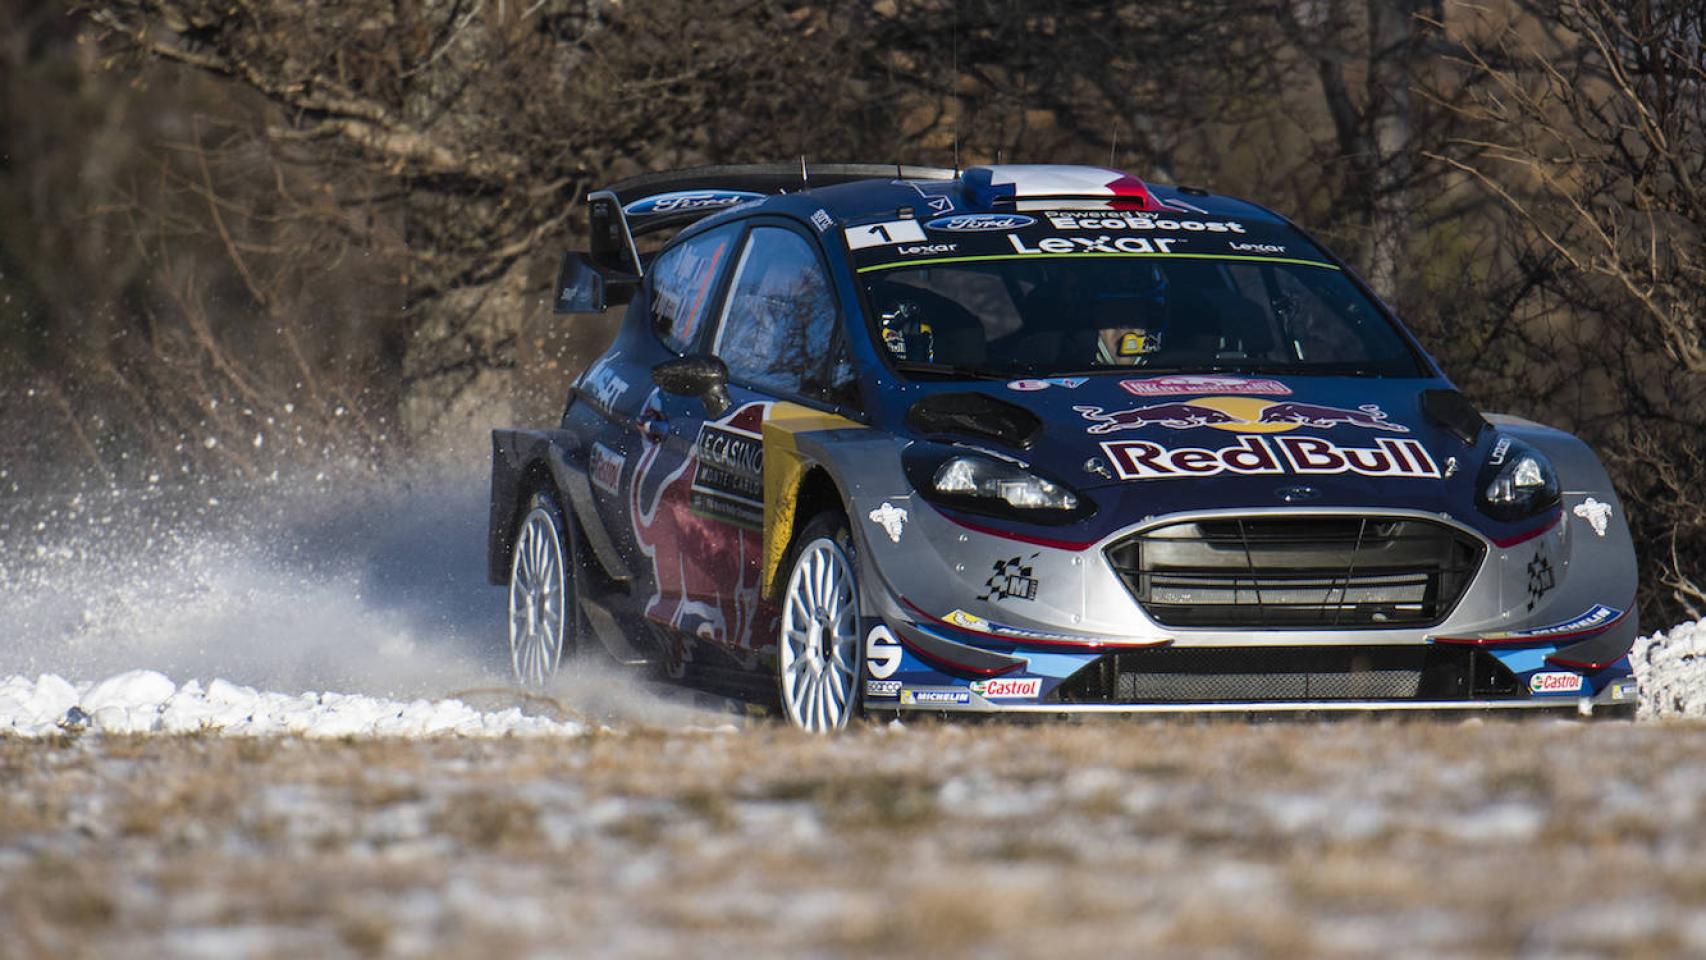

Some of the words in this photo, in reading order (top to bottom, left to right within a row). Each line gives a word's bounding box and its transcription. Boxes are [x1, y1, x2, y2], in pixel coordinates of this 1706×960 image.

[652, 195, 741, 212] Ford
[947, 215, 1017, 230] Ford
[1044, 211, 1133, 219] Powered
[1050, 217, 1247, 233] EcoBoost
[868, 225, 893, 243] 1
[898, 242, 957, 255] Lexar
[1006, 233, 1178, 254] Lexar
[1228, 241, 1287, 254] Lexar
[712, 436, 764, 473] CASINO
[1102, 436, 1282, 478] Red
[1276, 437, 1440, 478] Bull
[987, 680, 1036, 696] Castrol
[1543, 675, 1579, 689] Castrol
[917, 692, 969, 702] MICHELIN
